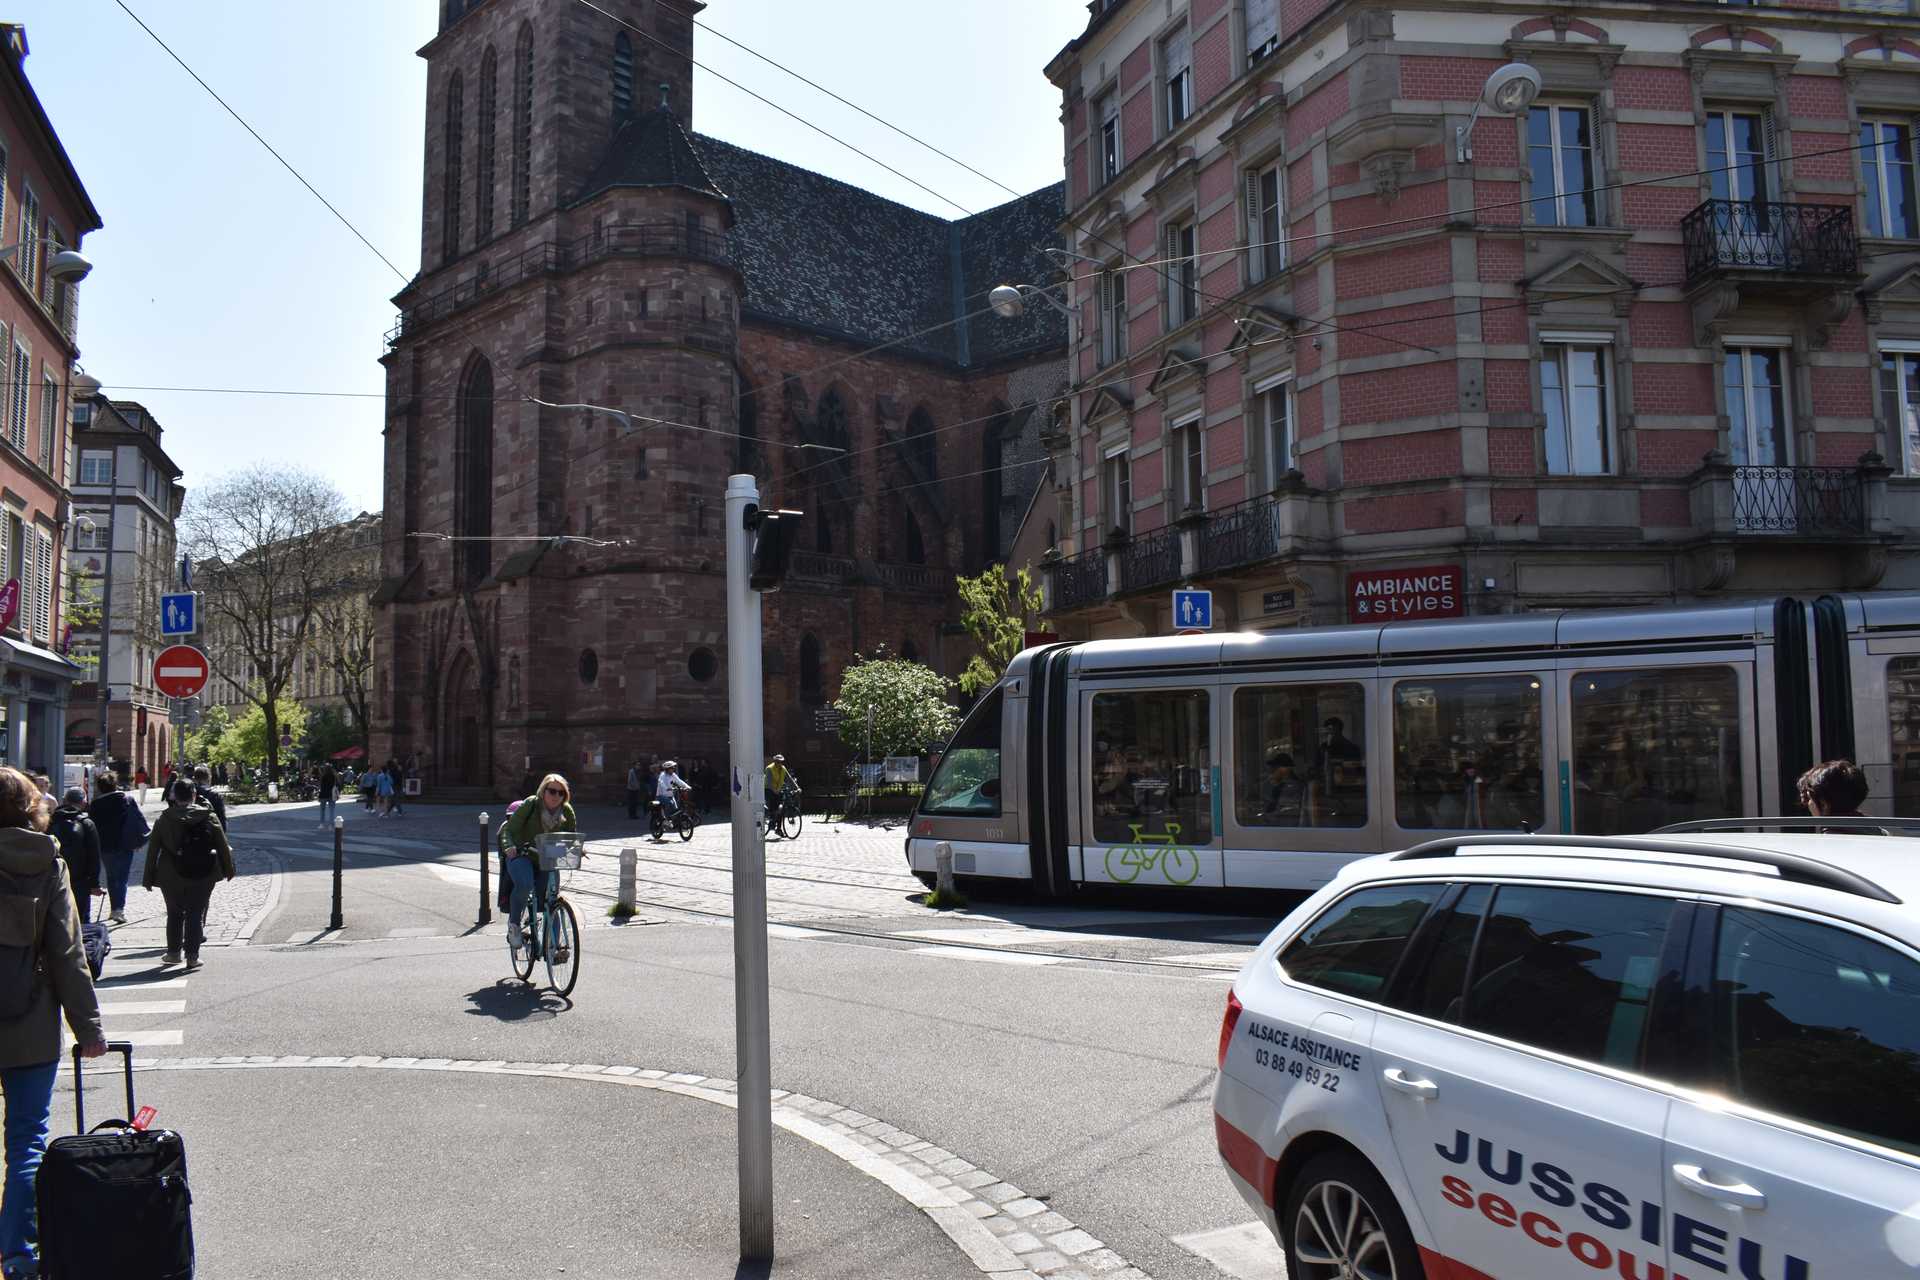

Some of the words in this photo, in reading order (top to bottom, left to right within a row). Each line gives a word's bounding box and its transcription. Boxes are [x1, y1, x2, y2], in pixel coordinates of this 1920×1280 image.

[1354, 575, 1453, 597] AMBIANCE
[1359, 600, 1369, 613] &
[1374, 595, 1454, 615] styles
[1248, 1022, 1289, 1048] ALSACE
[1290, 1036, 1361, 1071] ASSITANCE
[1256, 1048, 1269, 1067] 03
[1271, 1054, 1286, 1072] 88
[1288, 1060, 1303, 1079] 49
[1305, 1066, 1321, 1085] 69
[1321, 1073, 1340, 1093] 22
[1435, 1129, 1809, 1280] JUSSIEU
[1440, 1175, 1691, 1280] secou
